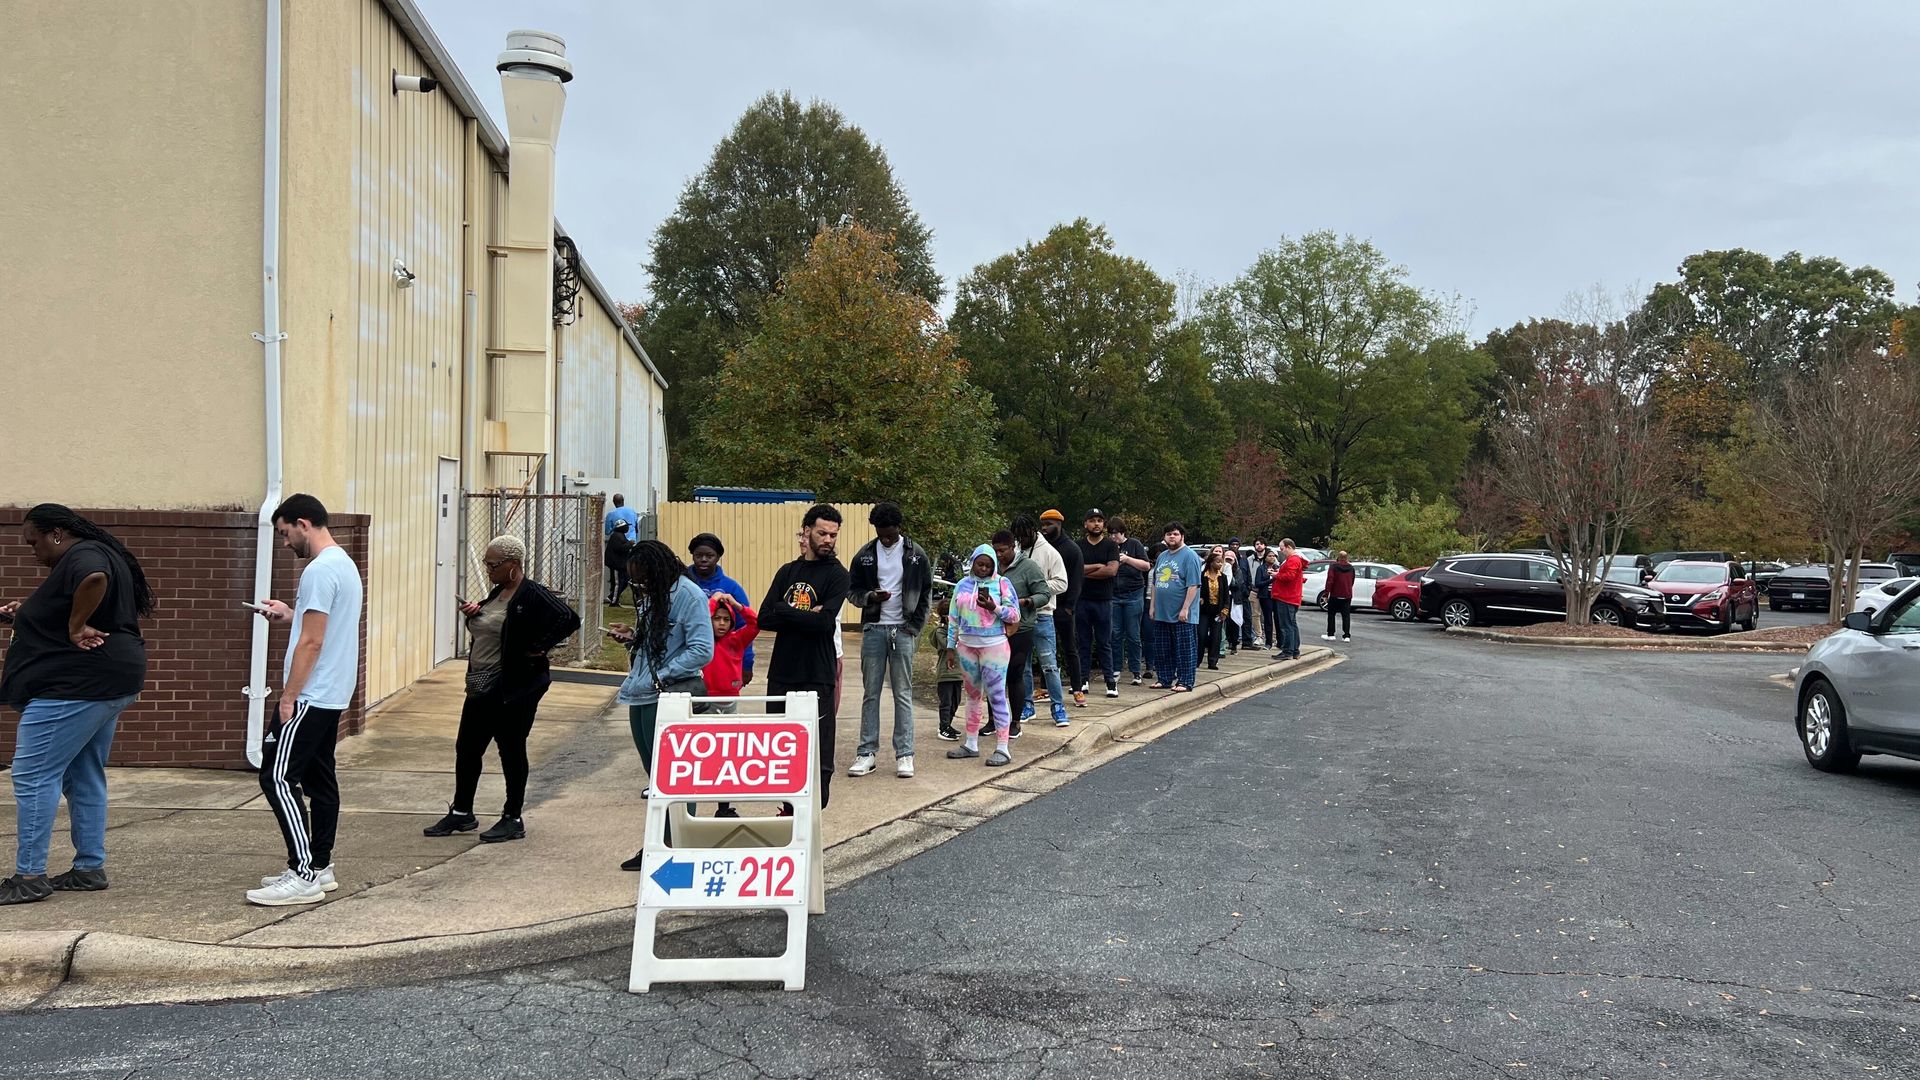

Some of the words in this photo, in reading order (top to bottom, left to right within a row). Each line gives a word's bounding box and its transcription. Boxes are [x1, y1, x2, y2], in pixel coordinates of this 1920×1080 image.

[668, 731, 797, 758] VOTING
[669, 759, 791, 787] PLACE
[701, 860, 737, 875] PCT.
[703, 876, 727, 897] #
[738, 855, 795, 897] 212
